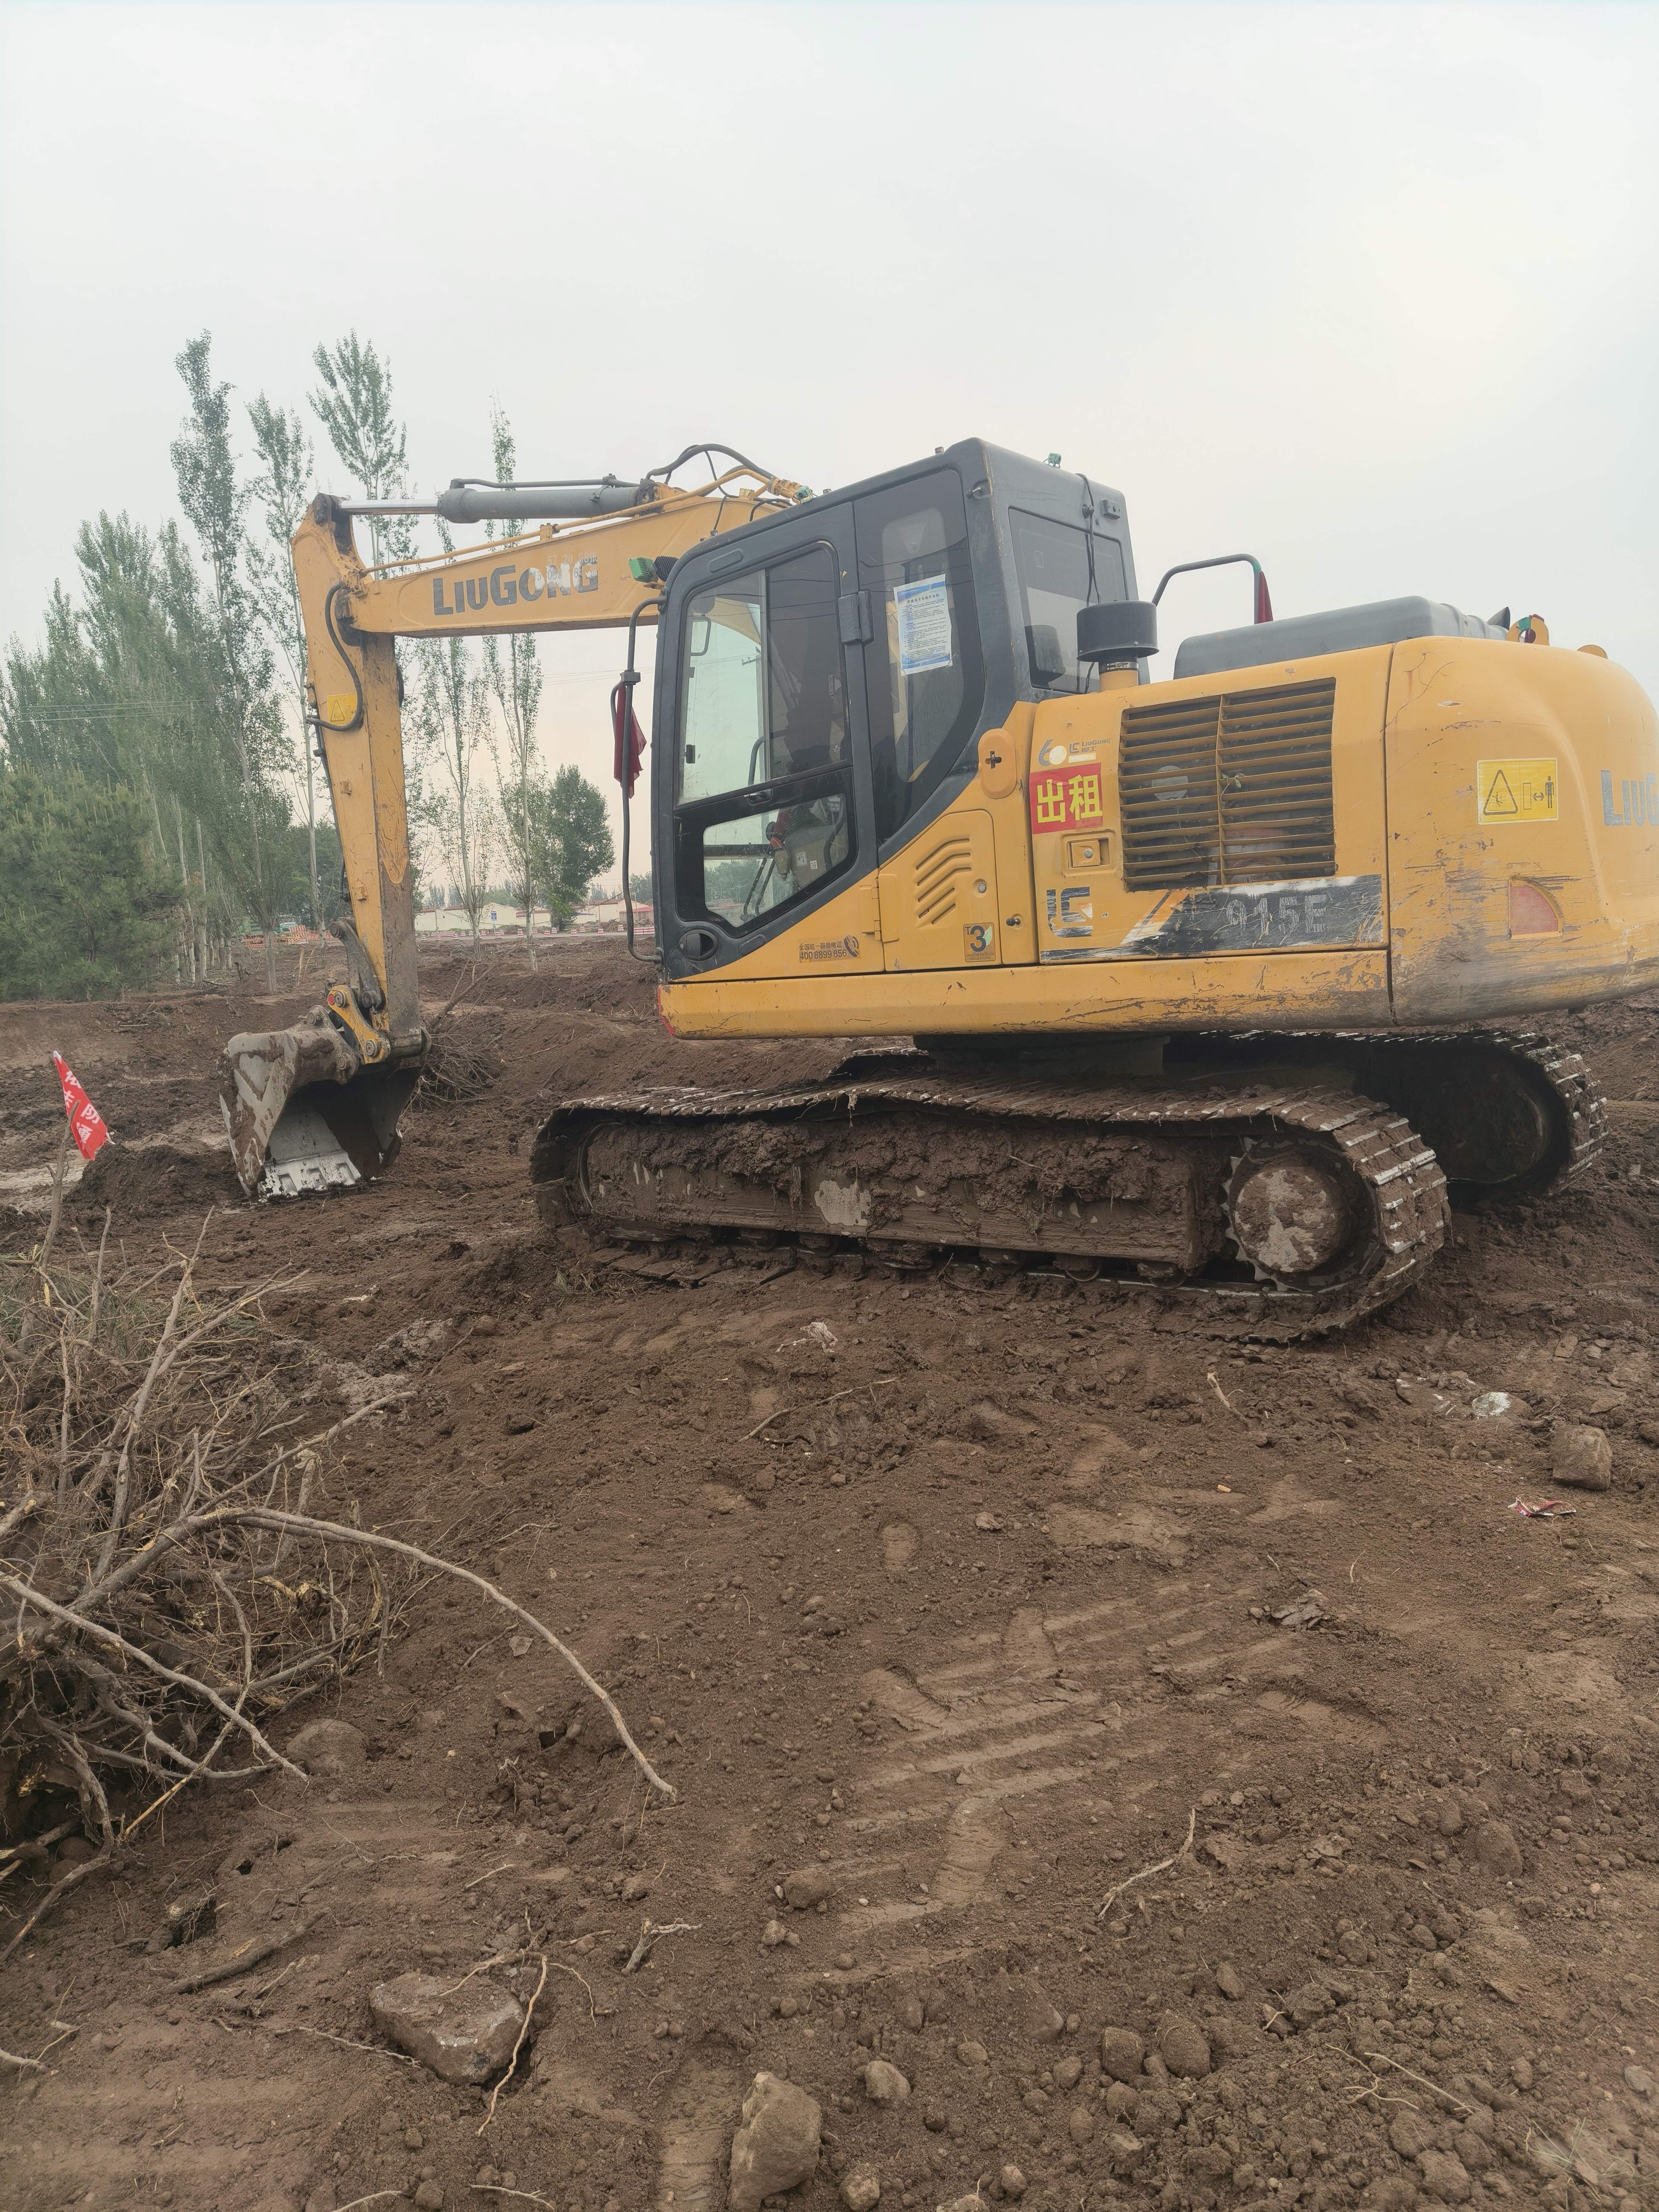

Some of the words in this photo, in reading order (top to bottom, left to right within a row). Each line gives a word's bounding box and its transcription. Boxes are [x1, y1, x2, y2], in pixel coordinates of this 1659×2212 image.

[433, 557, 598, 615] LIUGONG
[1082, 738, 1111, 746] LIUGONG
[1037, 775, 1103, 823] 出租
[799, 941, 842, 950] 全国统一服务电话
[800, 951, 813, 960] 400
[814, 950, 832, 958] 8899
[833, 949, 847, 958] 856
